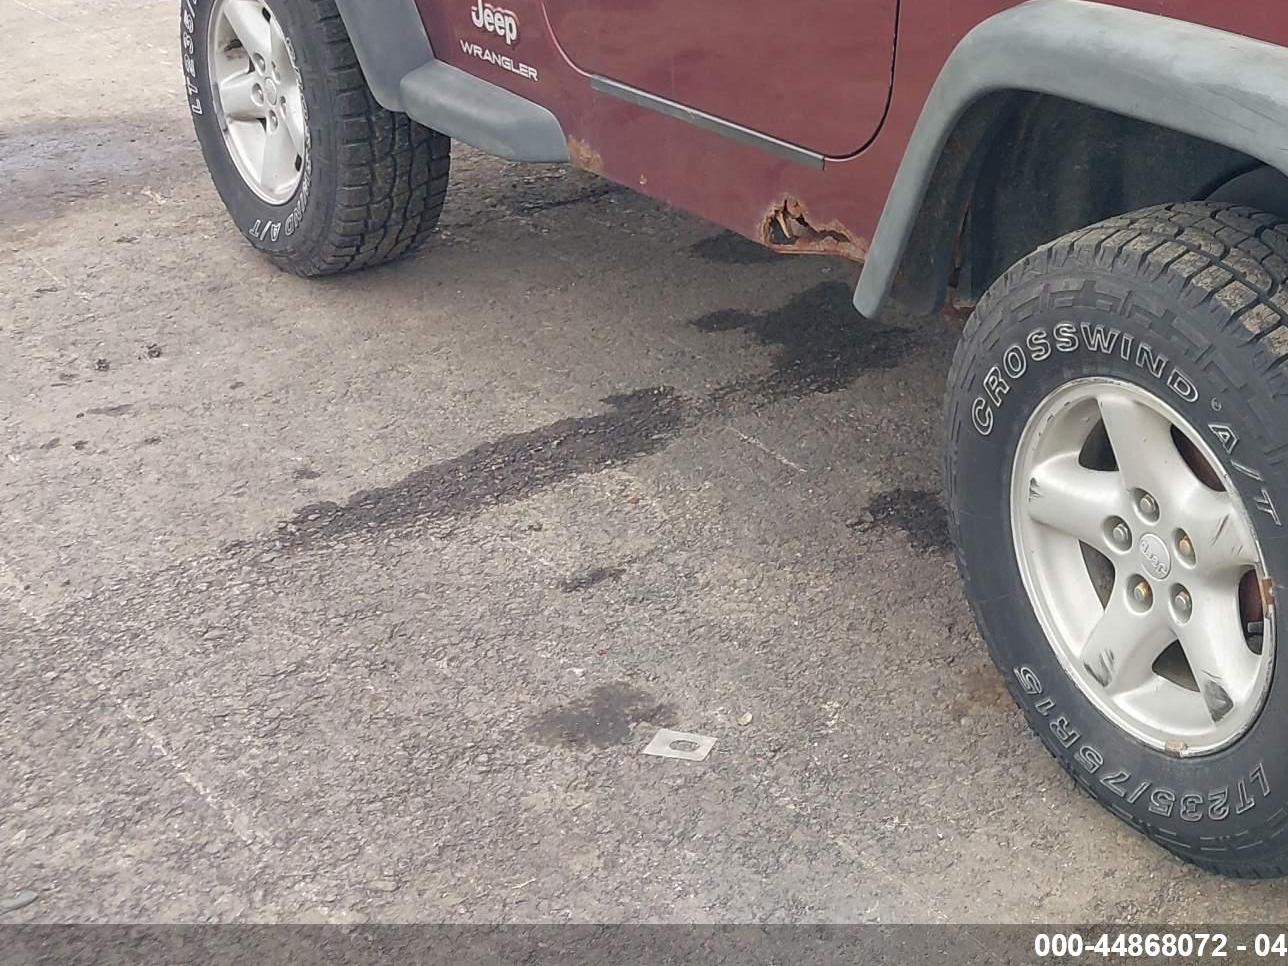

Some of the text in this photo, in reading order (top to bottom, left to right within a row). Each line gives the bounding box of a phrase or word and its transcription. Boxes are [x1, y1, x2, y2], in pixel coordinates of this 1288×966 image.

[459, 39, 539, 82] WRANGLER
[248, 217, 284, 243] A/T
[971, 320, 1283, 526] CROSSWIND A/T
[1014, 664, 1272, 822] LT235/75R15
